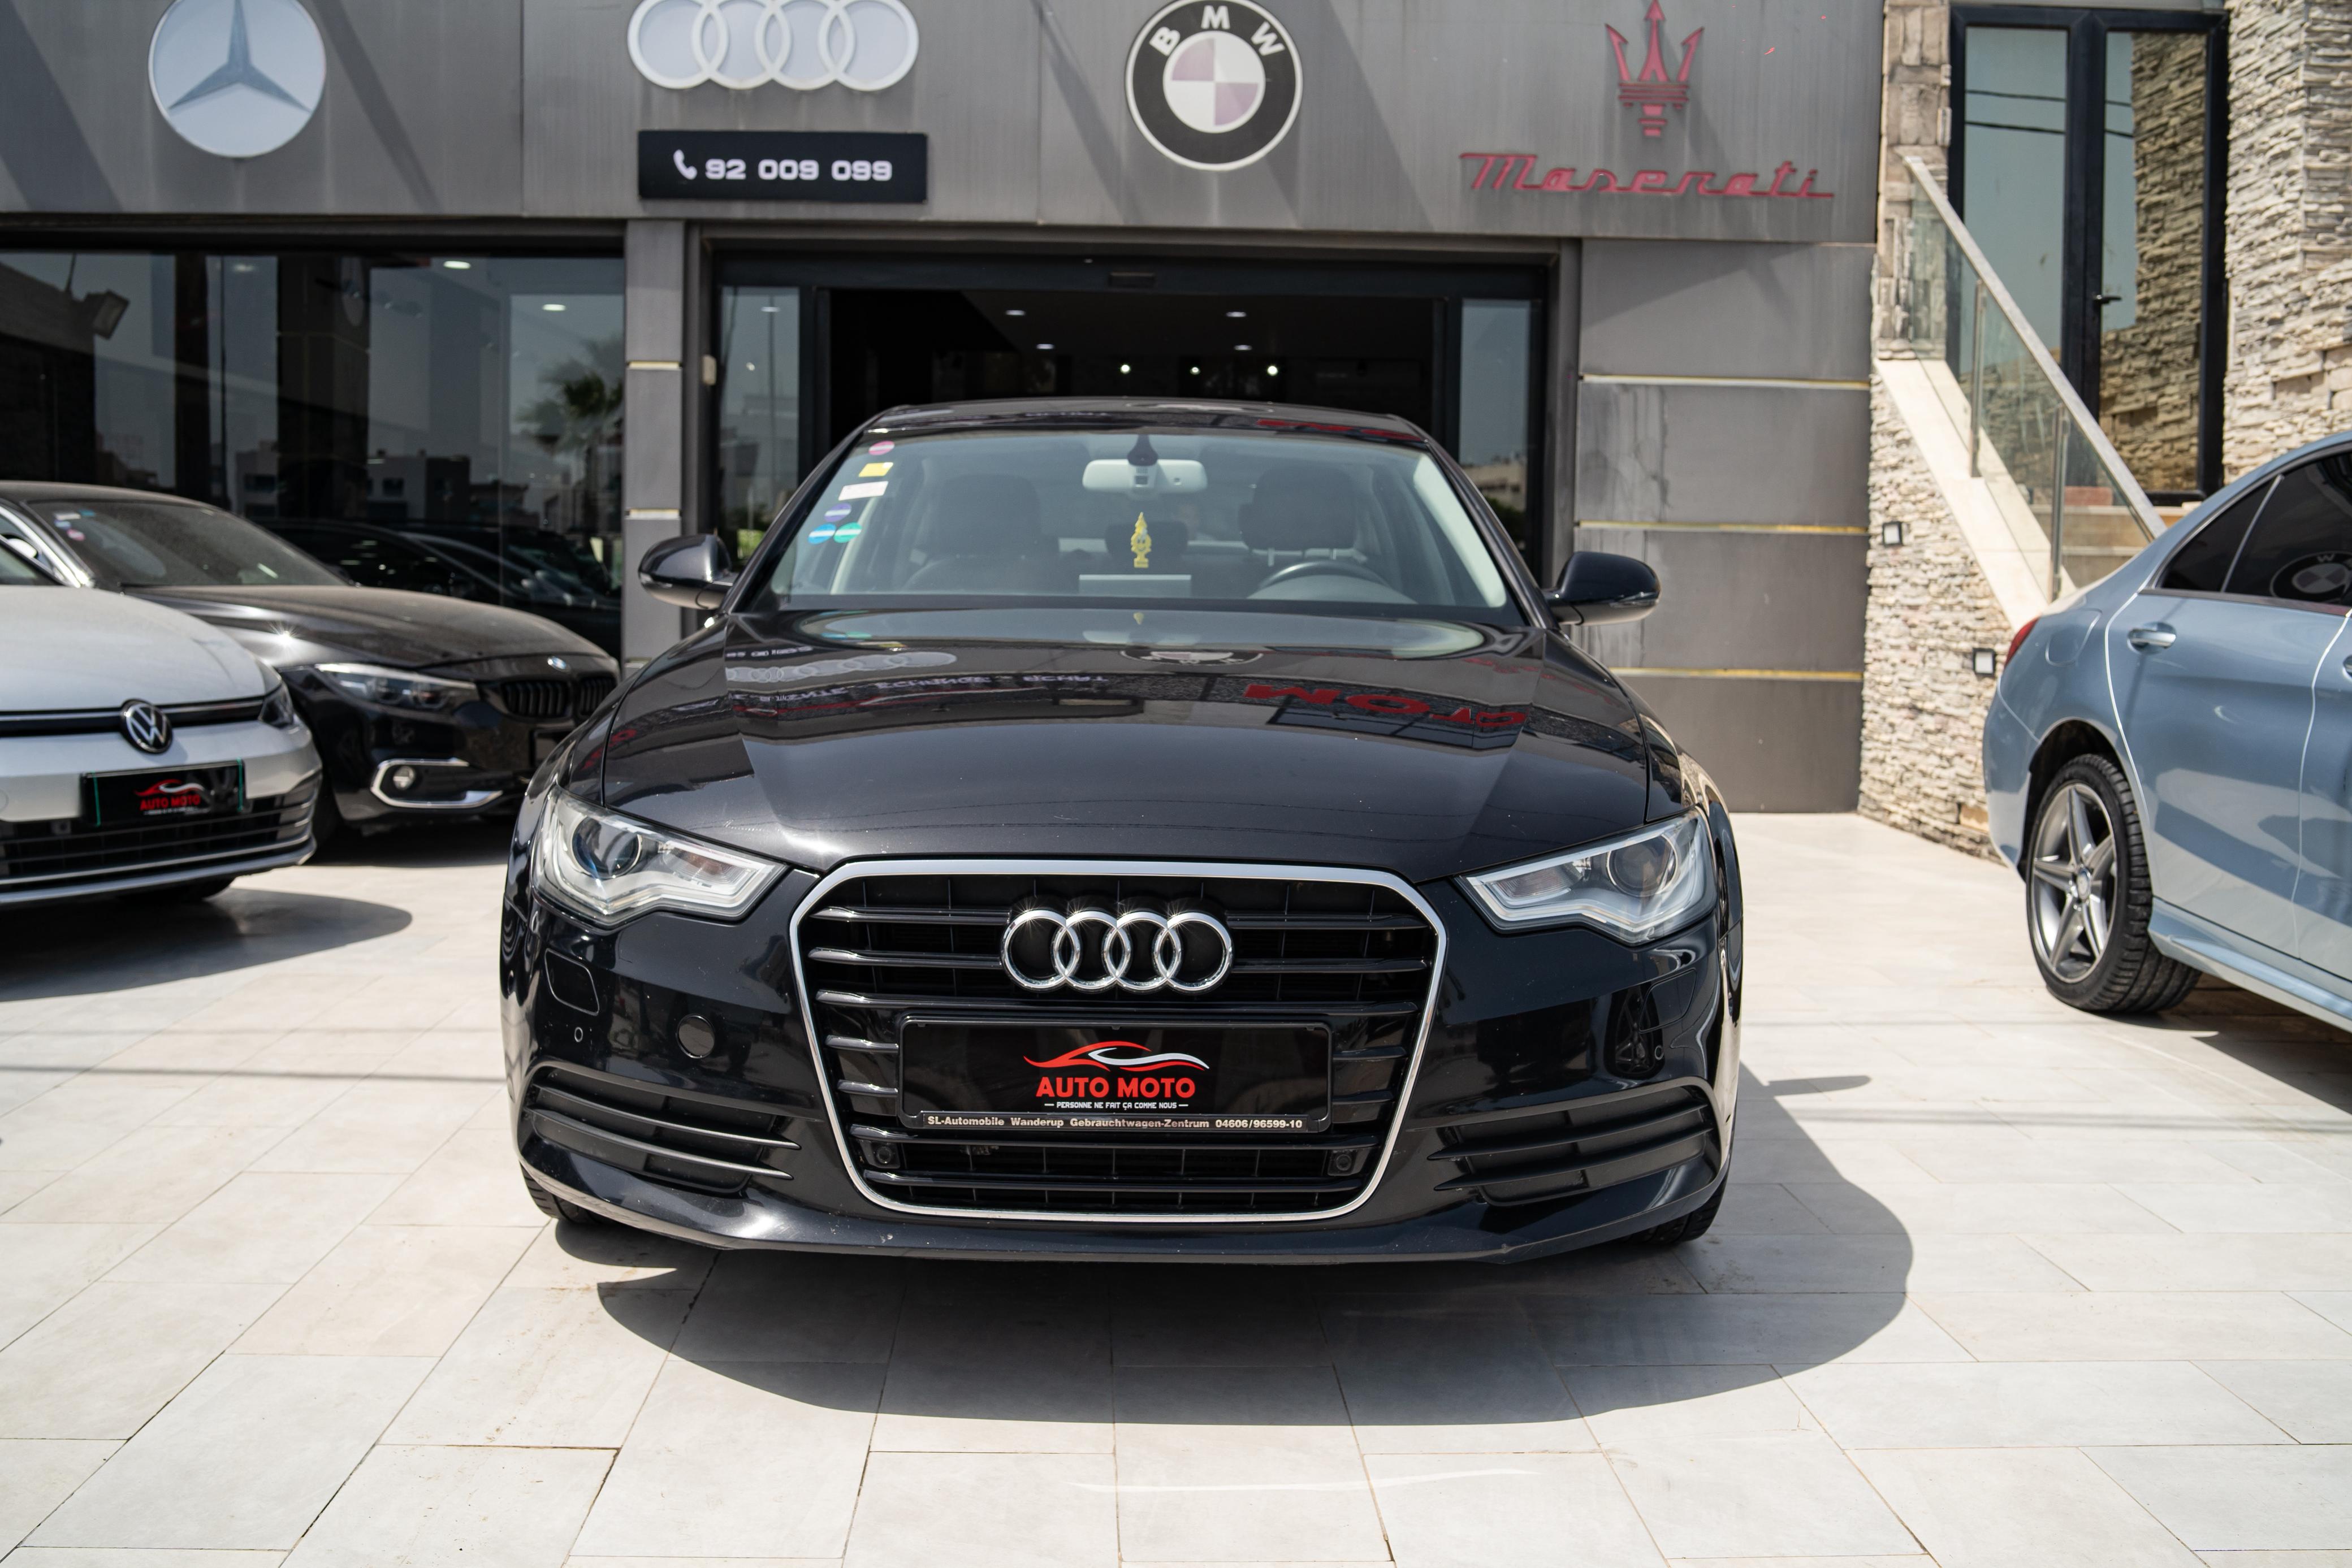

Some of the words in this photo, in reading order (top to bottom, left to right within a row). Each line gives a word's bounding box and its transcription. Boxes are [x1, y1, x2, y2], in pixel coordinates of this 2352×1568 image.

[1149, 5, 1285, 56] BMW
[705, 159, 746, 180] 92
[758, 159, 819, 180] 009
[831, 160, 892, 181] 099
[1459, 152, 1834, 198] Maserati
[140, 796, 168, 810] AUTO
[171, 794, 200, 807] MOTO
[1036, 1076, 1109, 1098] AUTO
[1117, 1077, 1195, 1098] MOTO
[928, 1116, 1005, 1126] SL-Automobile
[1010, 1117, 1064, 1128] Wanderup
[1070, 1117, 1209, 1129] Gebrauchtwagen-Zentrum
[1215, 1119, 1303, 1129] 04606/96599-10
